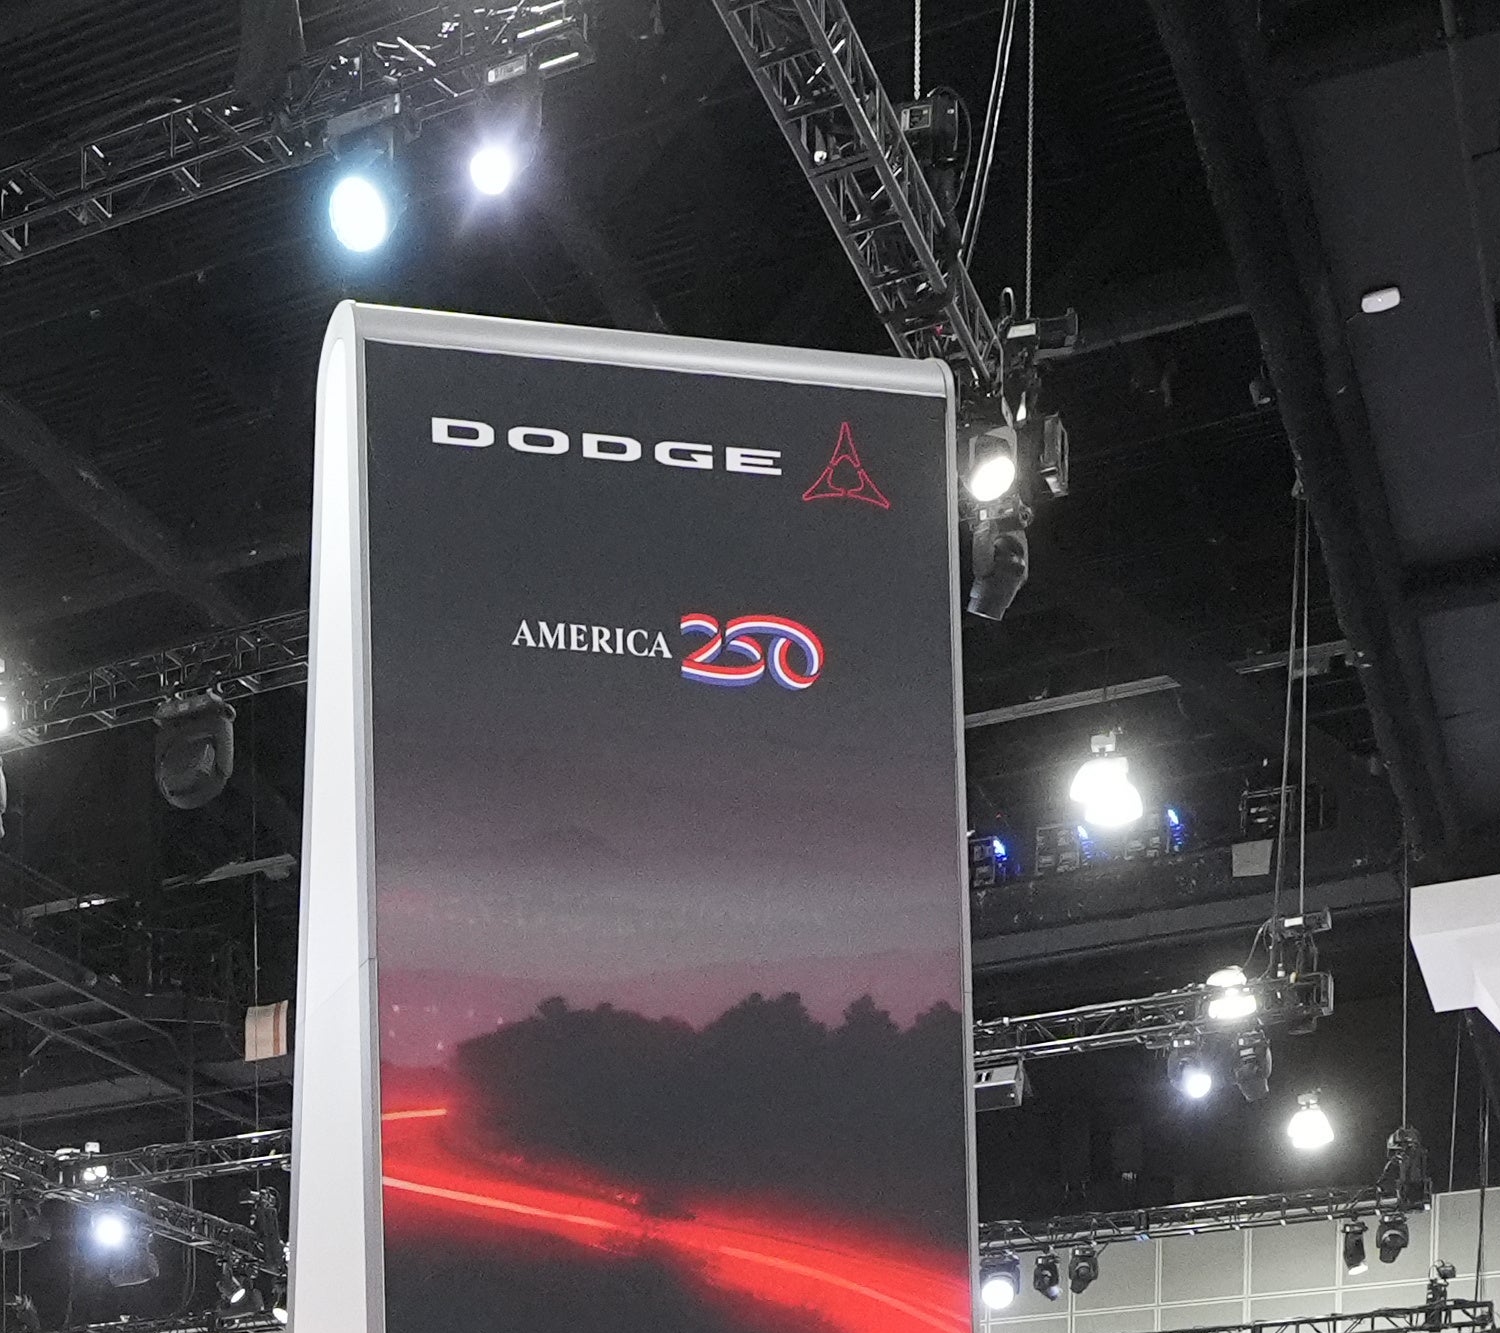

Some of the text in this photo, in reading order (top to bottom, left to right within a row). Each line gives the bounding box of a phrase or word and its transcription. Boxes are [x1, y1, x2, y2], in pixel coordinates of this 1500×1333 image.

[431, 416, 783, 476] DODGE
[512, 612, 825, 691] AMERICA 250
